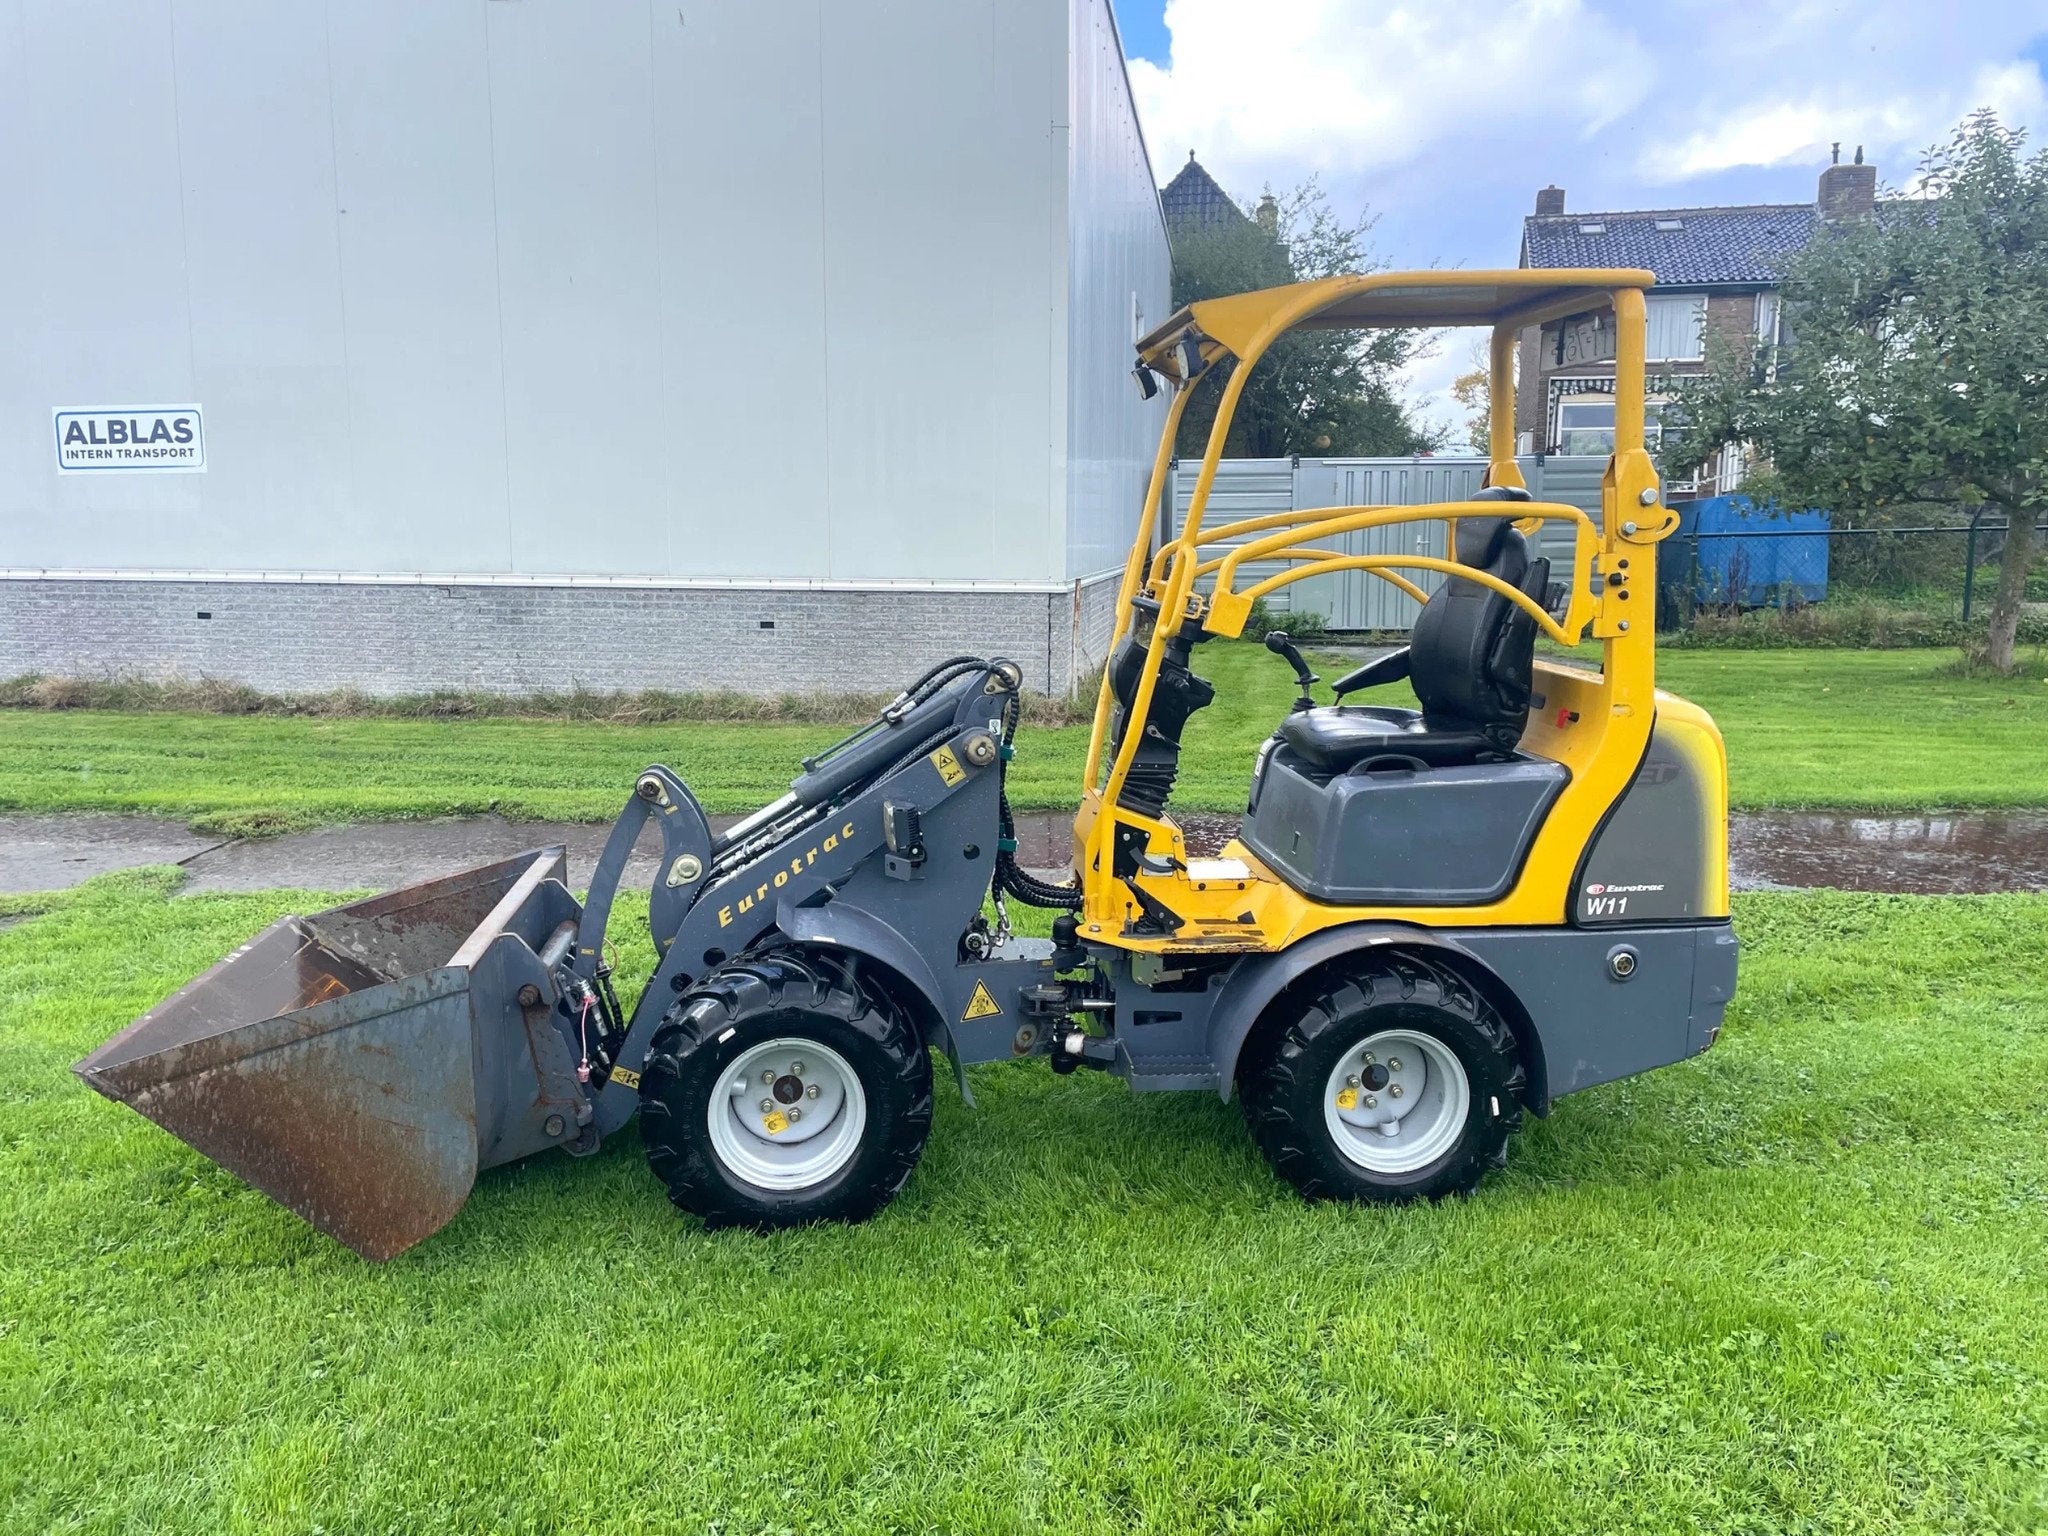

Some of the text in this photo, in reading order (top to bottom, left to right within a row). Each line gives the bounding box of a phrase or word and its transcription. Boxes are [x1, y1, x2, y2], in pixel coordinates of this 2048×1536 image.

[64, 418, 194, 445] ALBLAS
[66, 448, 195, 460] INTERN TRANSPORT
[717, 822, 854, 928] Eurotrac
[1606, 884, 1665, 893] Eurotrac
[1587, 896, 1628, 916] W11
